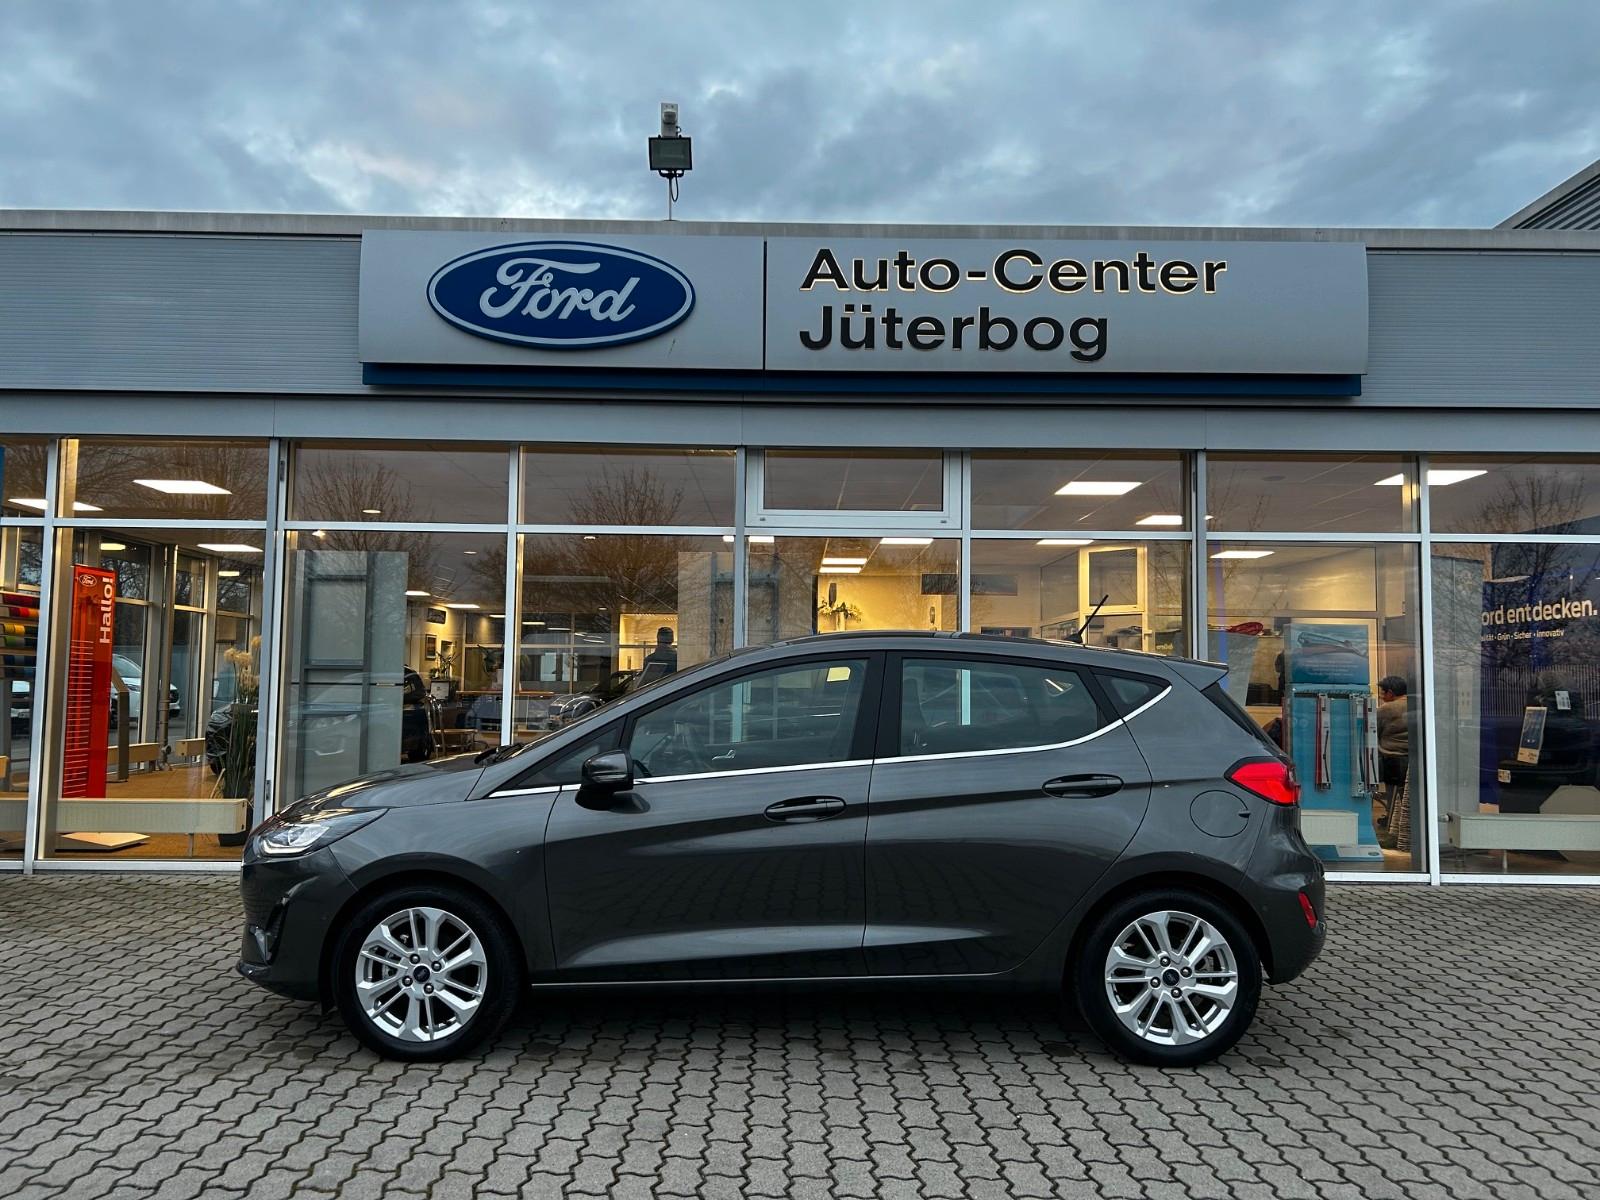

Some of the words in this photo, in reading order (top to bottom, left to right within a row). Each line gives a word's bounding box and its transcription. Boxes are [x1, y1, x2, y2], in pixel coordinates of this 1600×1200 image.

[480, 257, 641, 323] Ford
[799, 247, 1228, 295] Auto-Center
[799, 303, 1109, 364] Jüterbog
[99, 576, 114, 644] Hallo!
[1481, 604, 1505, 626] ord
[1507, 597, 1598, 624] entdecken.
